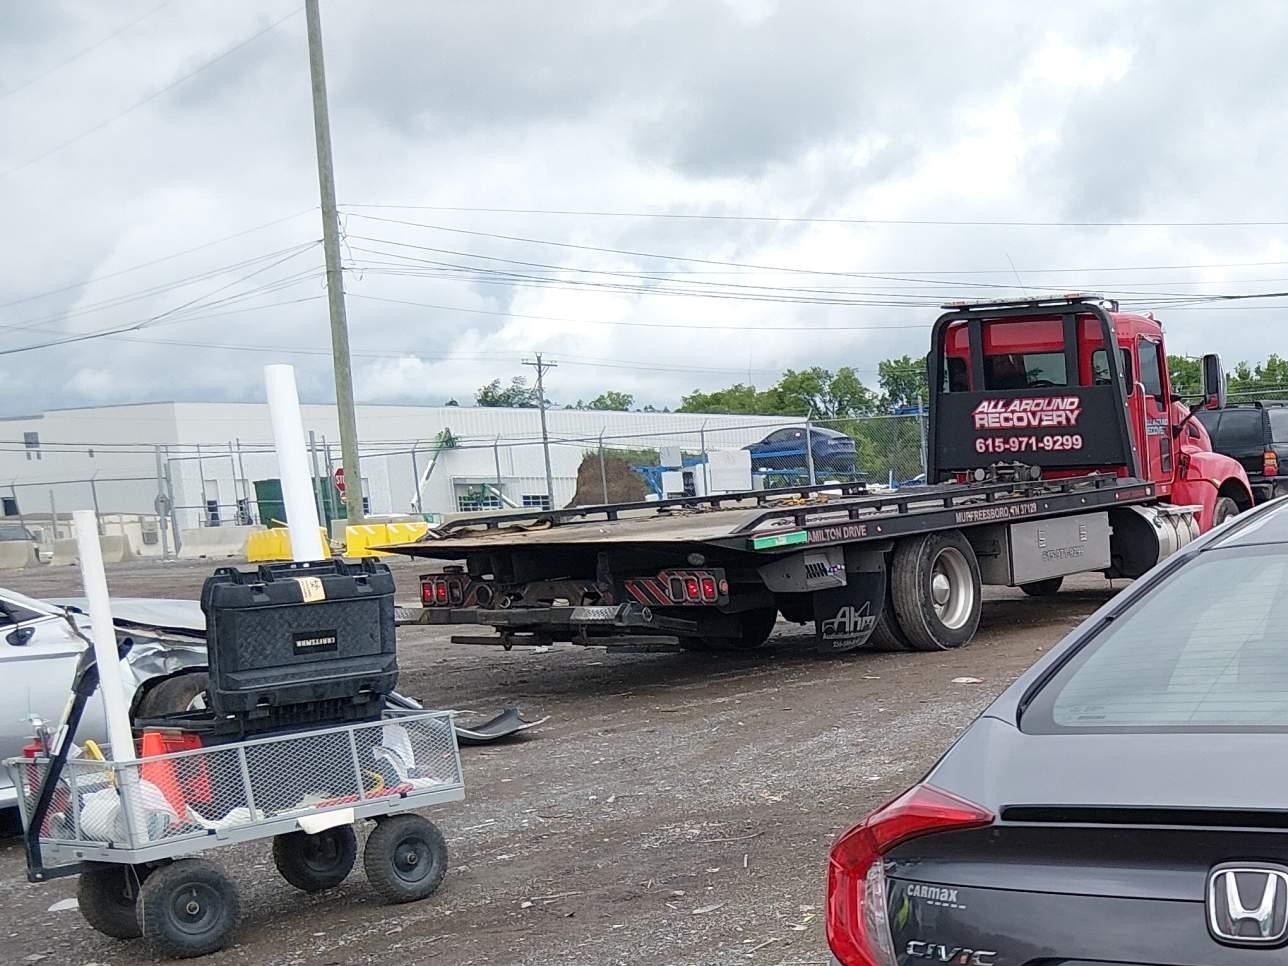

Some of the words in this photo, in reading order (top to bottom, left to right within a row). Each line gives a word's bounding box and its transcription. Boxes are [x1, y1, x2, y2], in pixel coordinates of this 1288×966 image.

[976, 401, 1005, 412] ALL
[1007, 398, 1080, 411] AROUND
[975, 409, 1079, 427] RECOVERY
[975, 435, 1082, 452] 615-971-9299
[807, 528, 841, 543] AMILTON
[843, 525, 867, 539] DRIVE
